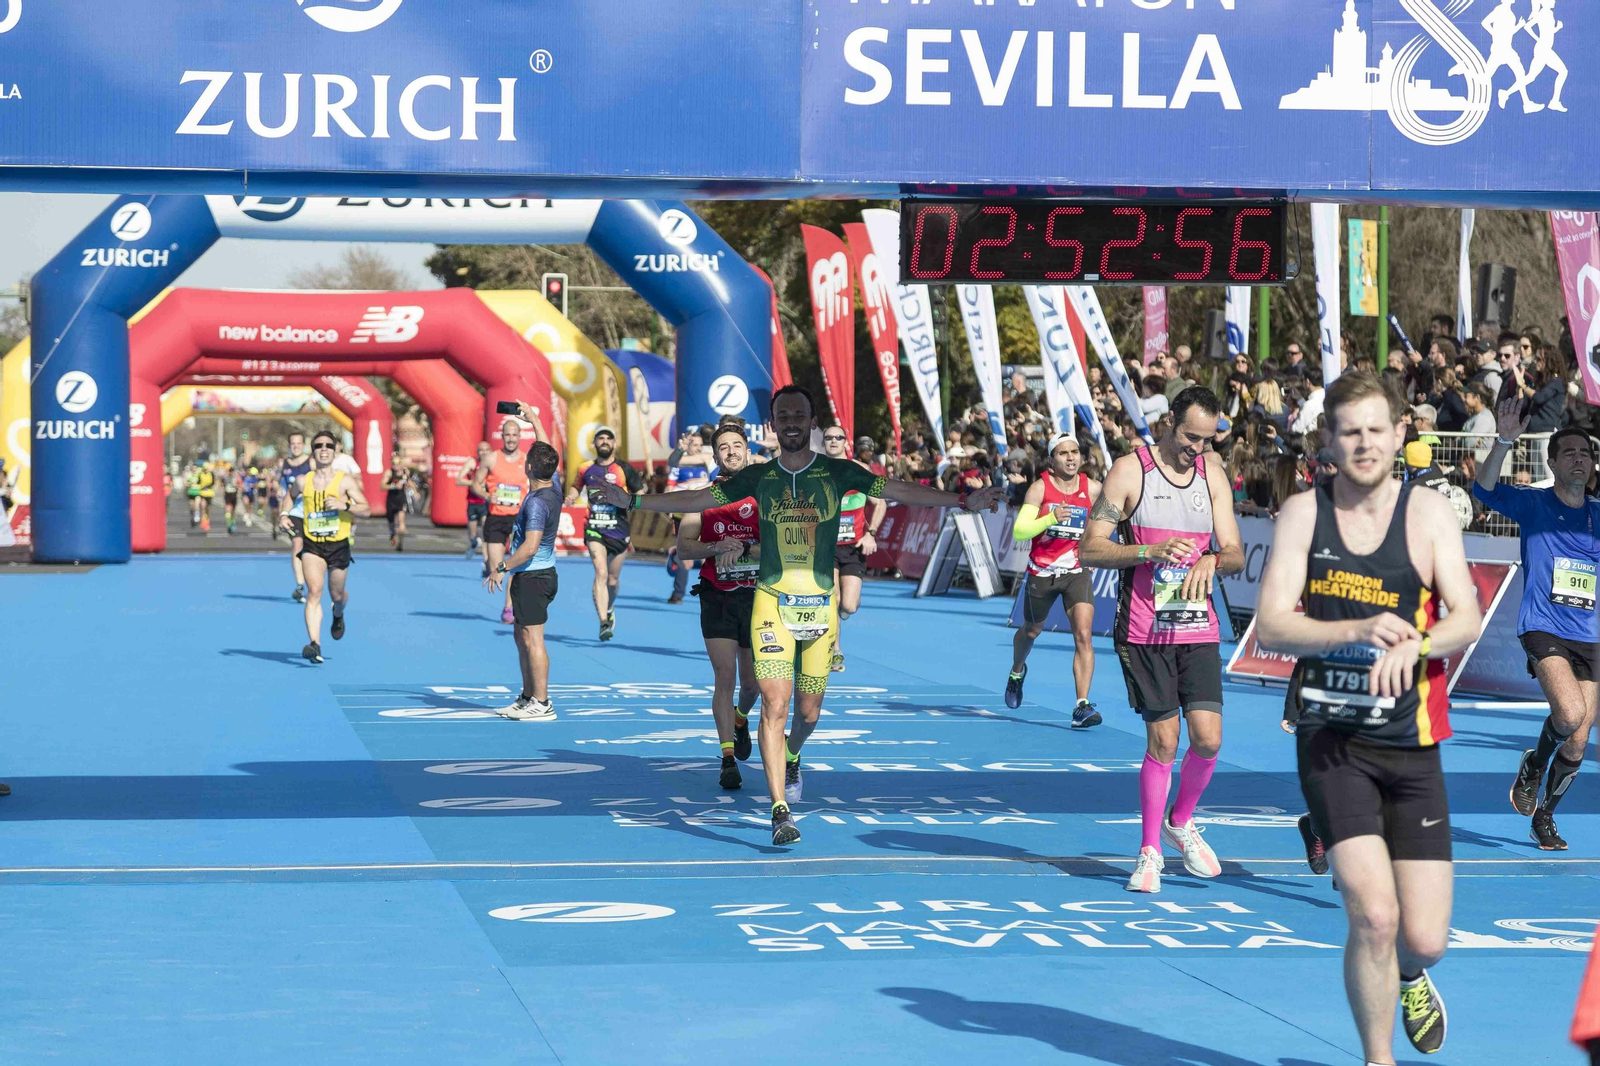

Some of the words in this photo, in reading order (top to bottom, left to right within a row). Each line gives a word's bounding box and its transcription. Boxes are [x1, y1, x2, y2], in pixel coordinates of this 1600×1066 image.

[843, 27, 1242, 110] SEVILLA
[174, 70, 519, 142] ZURICH
[909, 206, 1272, 281] 02:52:56
[80, 248, 170, 268] ZURICH
[633, 253, 720, 273] ZURICH
[218, 325, 260, 340] new
[260, 324, 339, 343] balance
[35, 419, 116, 440] ZURICH
[1571, 562, 1596, 573] ZURICH
[1327, 569, 1384, 591] LONDON
[1570, 576, 1588, 589] 910
[1309, 579, 1400, 608] HEATHSIDE
[796, 611, 816, 623] 793
[710, 900, 1258, 914] ZURICH
[737, 918, 1296, 935] MARATÓN
[747, 932, 1344, 952] SEVILLA
[1412, 1010, 1441, 1043] BROOKS
